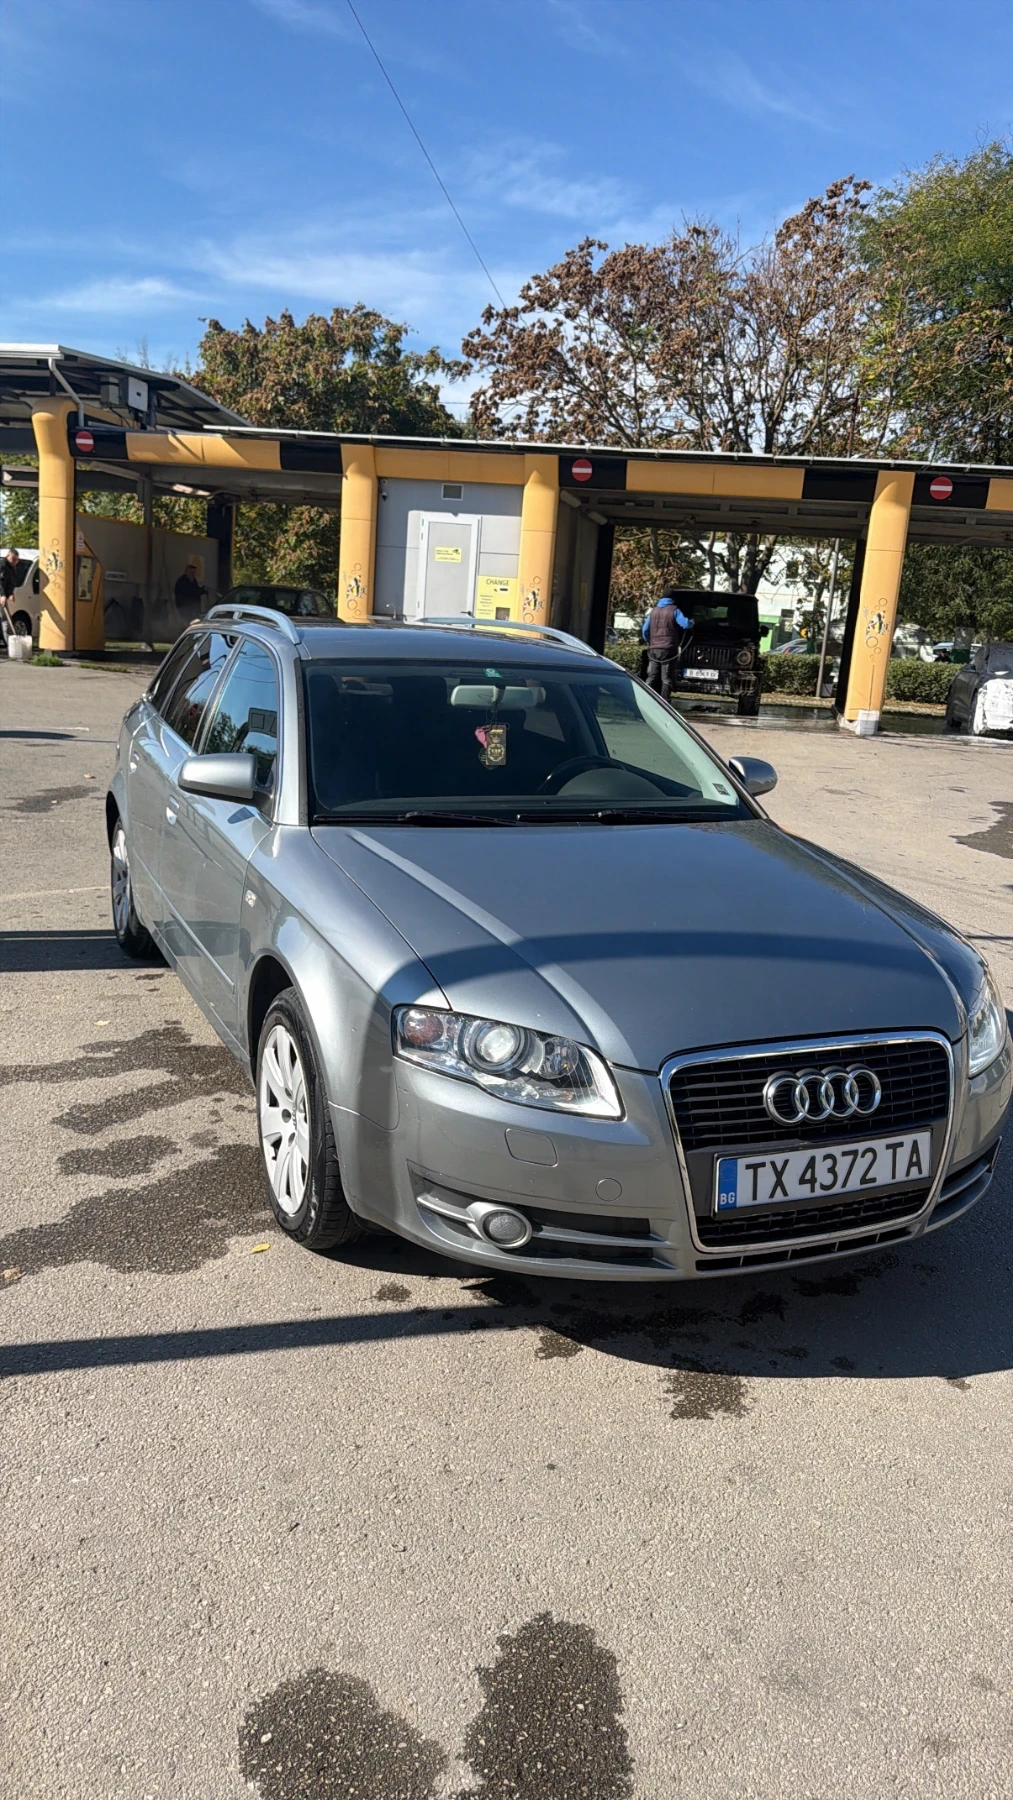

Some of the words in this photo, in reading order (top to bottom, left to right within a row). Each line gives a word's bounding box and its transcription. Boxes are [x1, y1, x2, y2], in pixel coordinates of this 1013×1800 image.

[486, 578, 510, 587] CHANGE
[745, 1158, 790, 1201] TX
[798, 1147, 878, 1193] 4372
[885, 1139, 923, 1180] TA
[720, 1191, 736, 1205] BG
